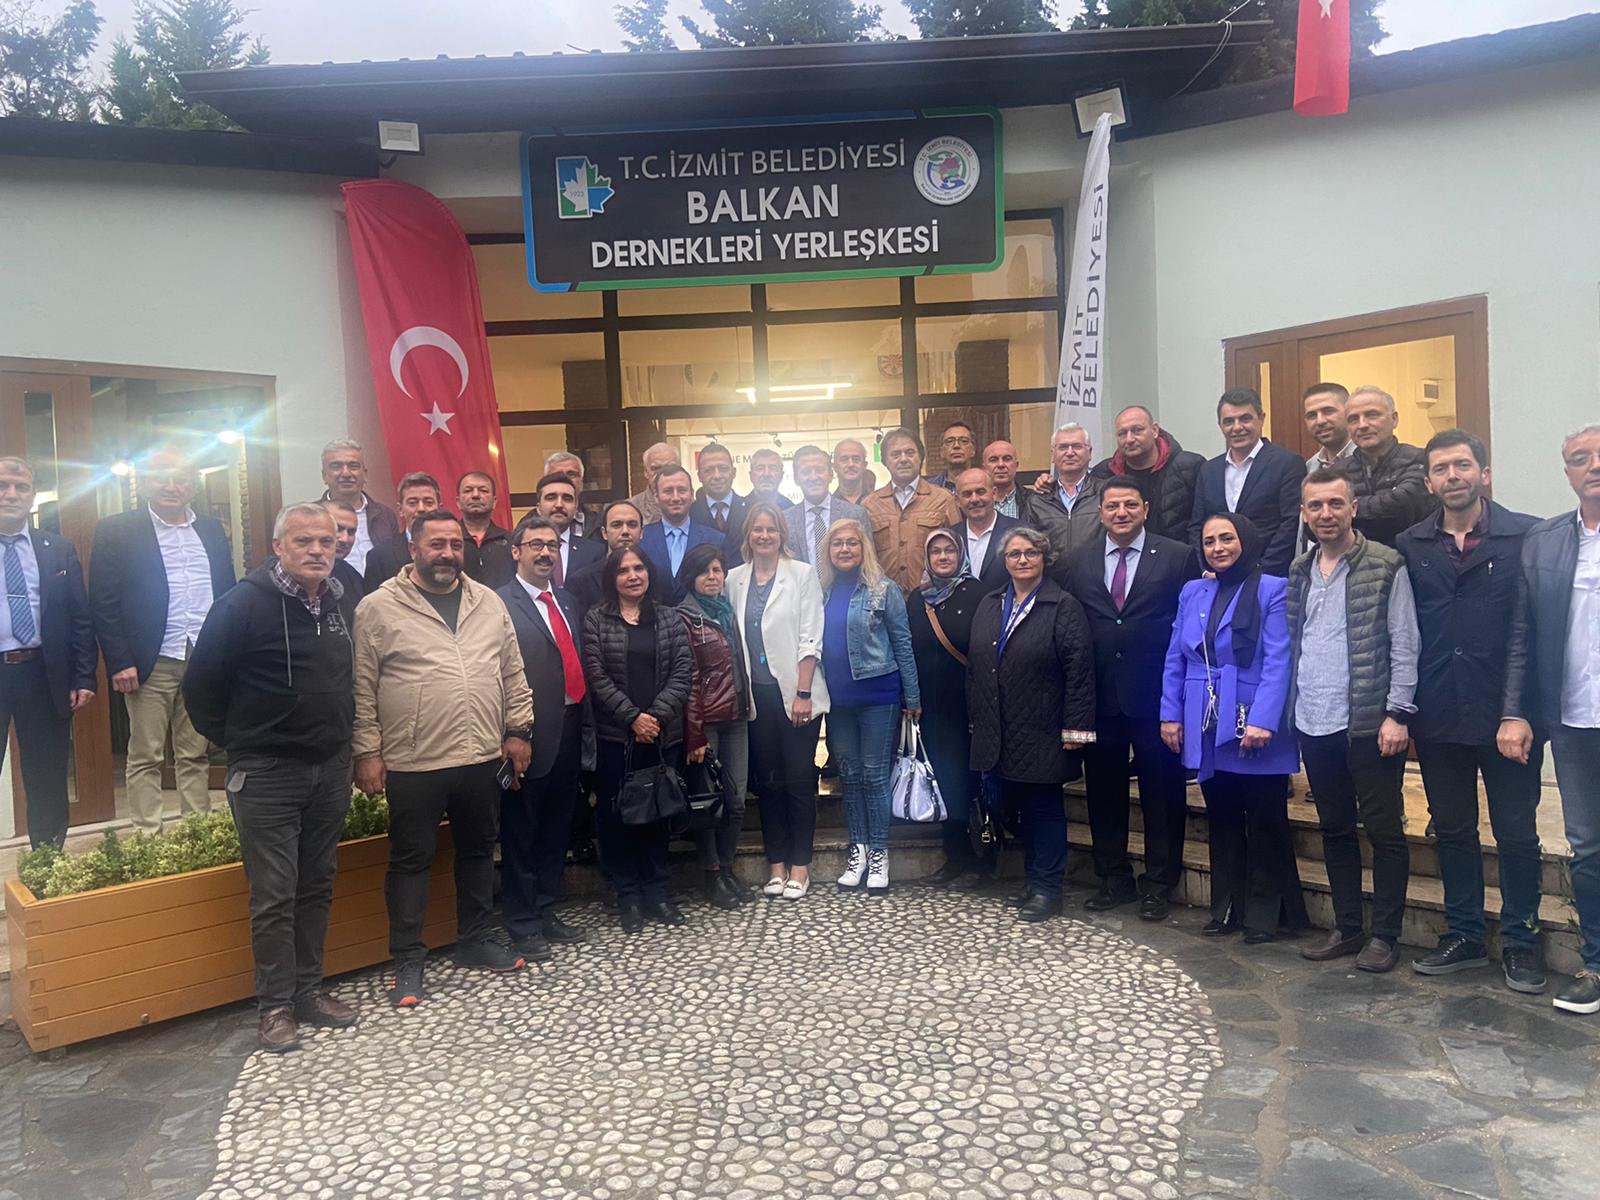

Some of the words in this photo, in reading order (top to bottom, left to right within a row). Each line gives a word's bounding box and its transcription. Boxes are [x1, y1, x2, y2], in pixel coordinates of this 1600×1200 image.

[752, 138, 905, 174] BELEDİYESİ
[687, 184, 839, 225] BALKAN
[591, 228, 763, 269] DERNEKLERİ
[773, 219, 939, 262] YERLEŞKESİ
[1083, 183, 1104, 408] BELEDİYESİ
[1067, 304, 1084, 406] İZMİT
